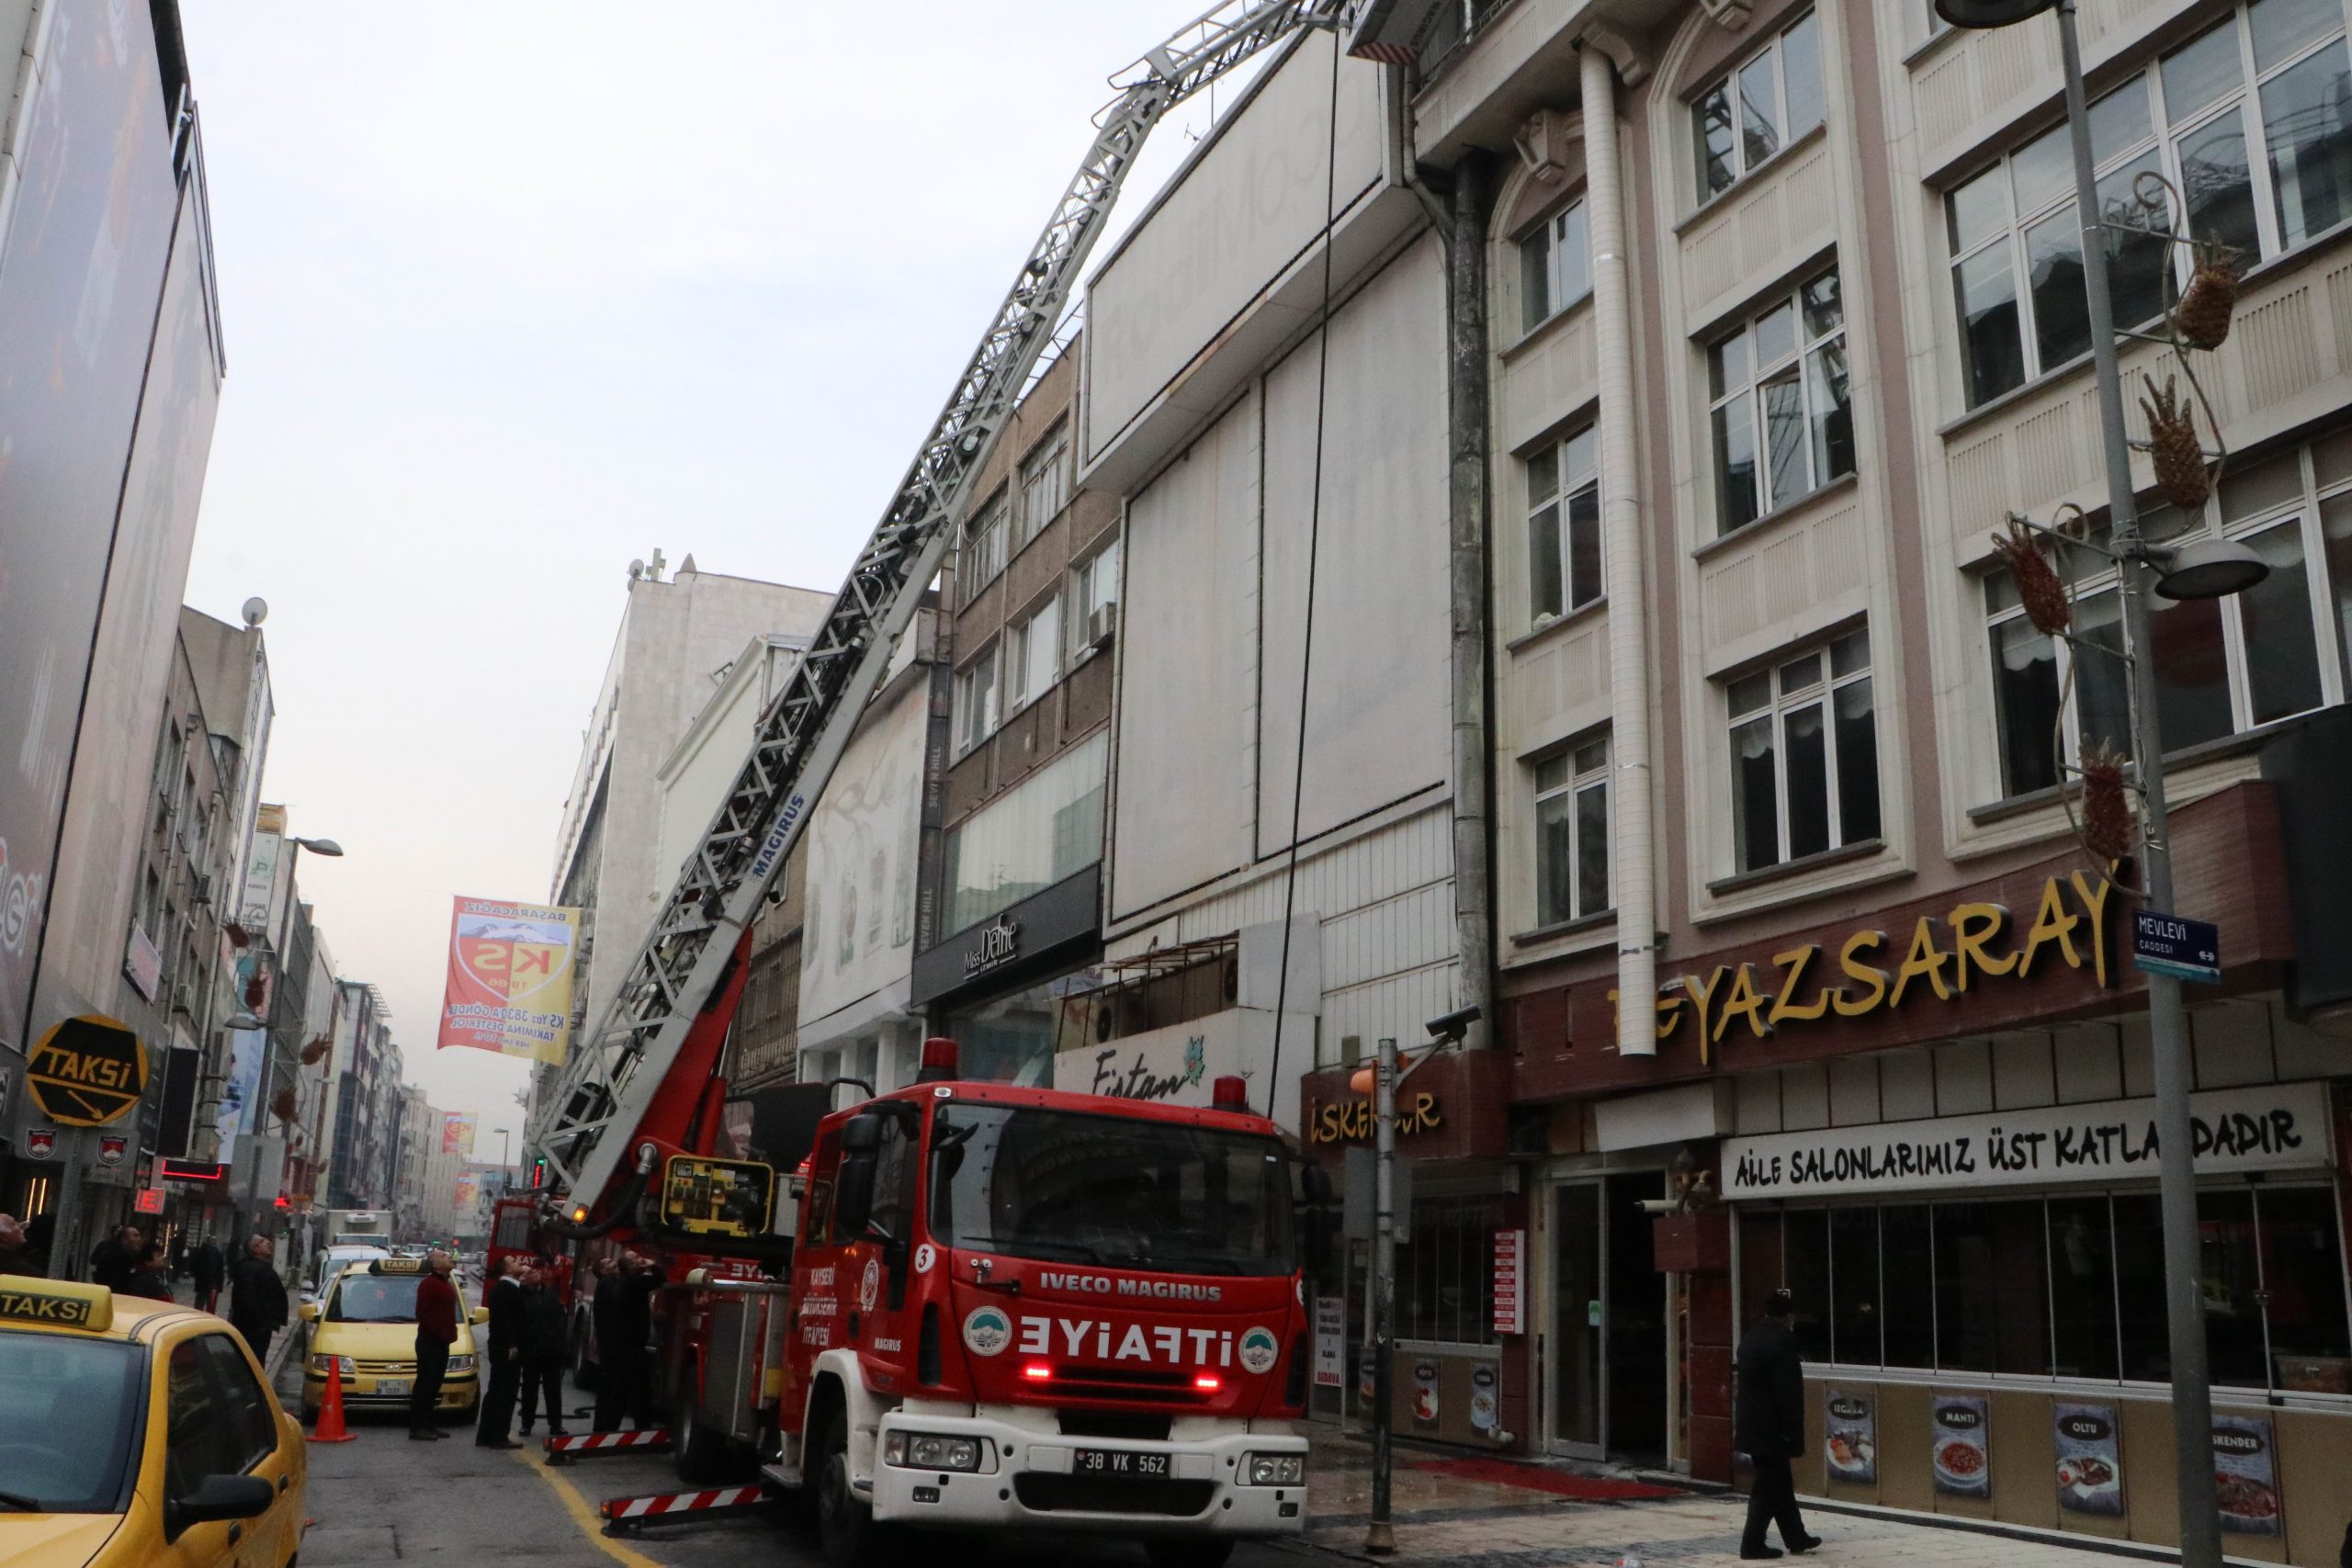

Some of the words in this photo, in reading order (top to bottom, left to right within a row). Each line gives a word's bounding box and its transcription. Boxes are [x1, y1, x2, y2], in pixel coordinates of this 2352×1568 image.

[752, 794, 805, 878] MAGIRUS
[2139, 916, 2187, 942] MEVLEVİ
[964, 950, 981, 972] Miss
[45, 1049, 131, 1089] TAKSİ
[1735, 1147, 1781, 1188] AİLE
[1789, 1137, 1975, 1184] SALONLARIMIZ
[1988, 1126, 2046, 1169] ÜST
[384, 1259, 417, 1269] TAKSİ
[918, 1248, 929, 1269] 3
[1040, 1272, 1112, 1294] IVECO
[1117, 1278, 1221, 1303] MAGIRUS
[0, 1294, 89, 1322] TAKSİ
[874, 1337, 902, 1352] MAGIRUS
[1945, 1412, 1975, 1423] MANTI
[2072, 1422, 2098, 1434] OLTU
[1086, 1451, 1104, 1470] 38
[1113, 1453, 1130, 1472] VK
[1138, 1455, 1166, 1473] 562
